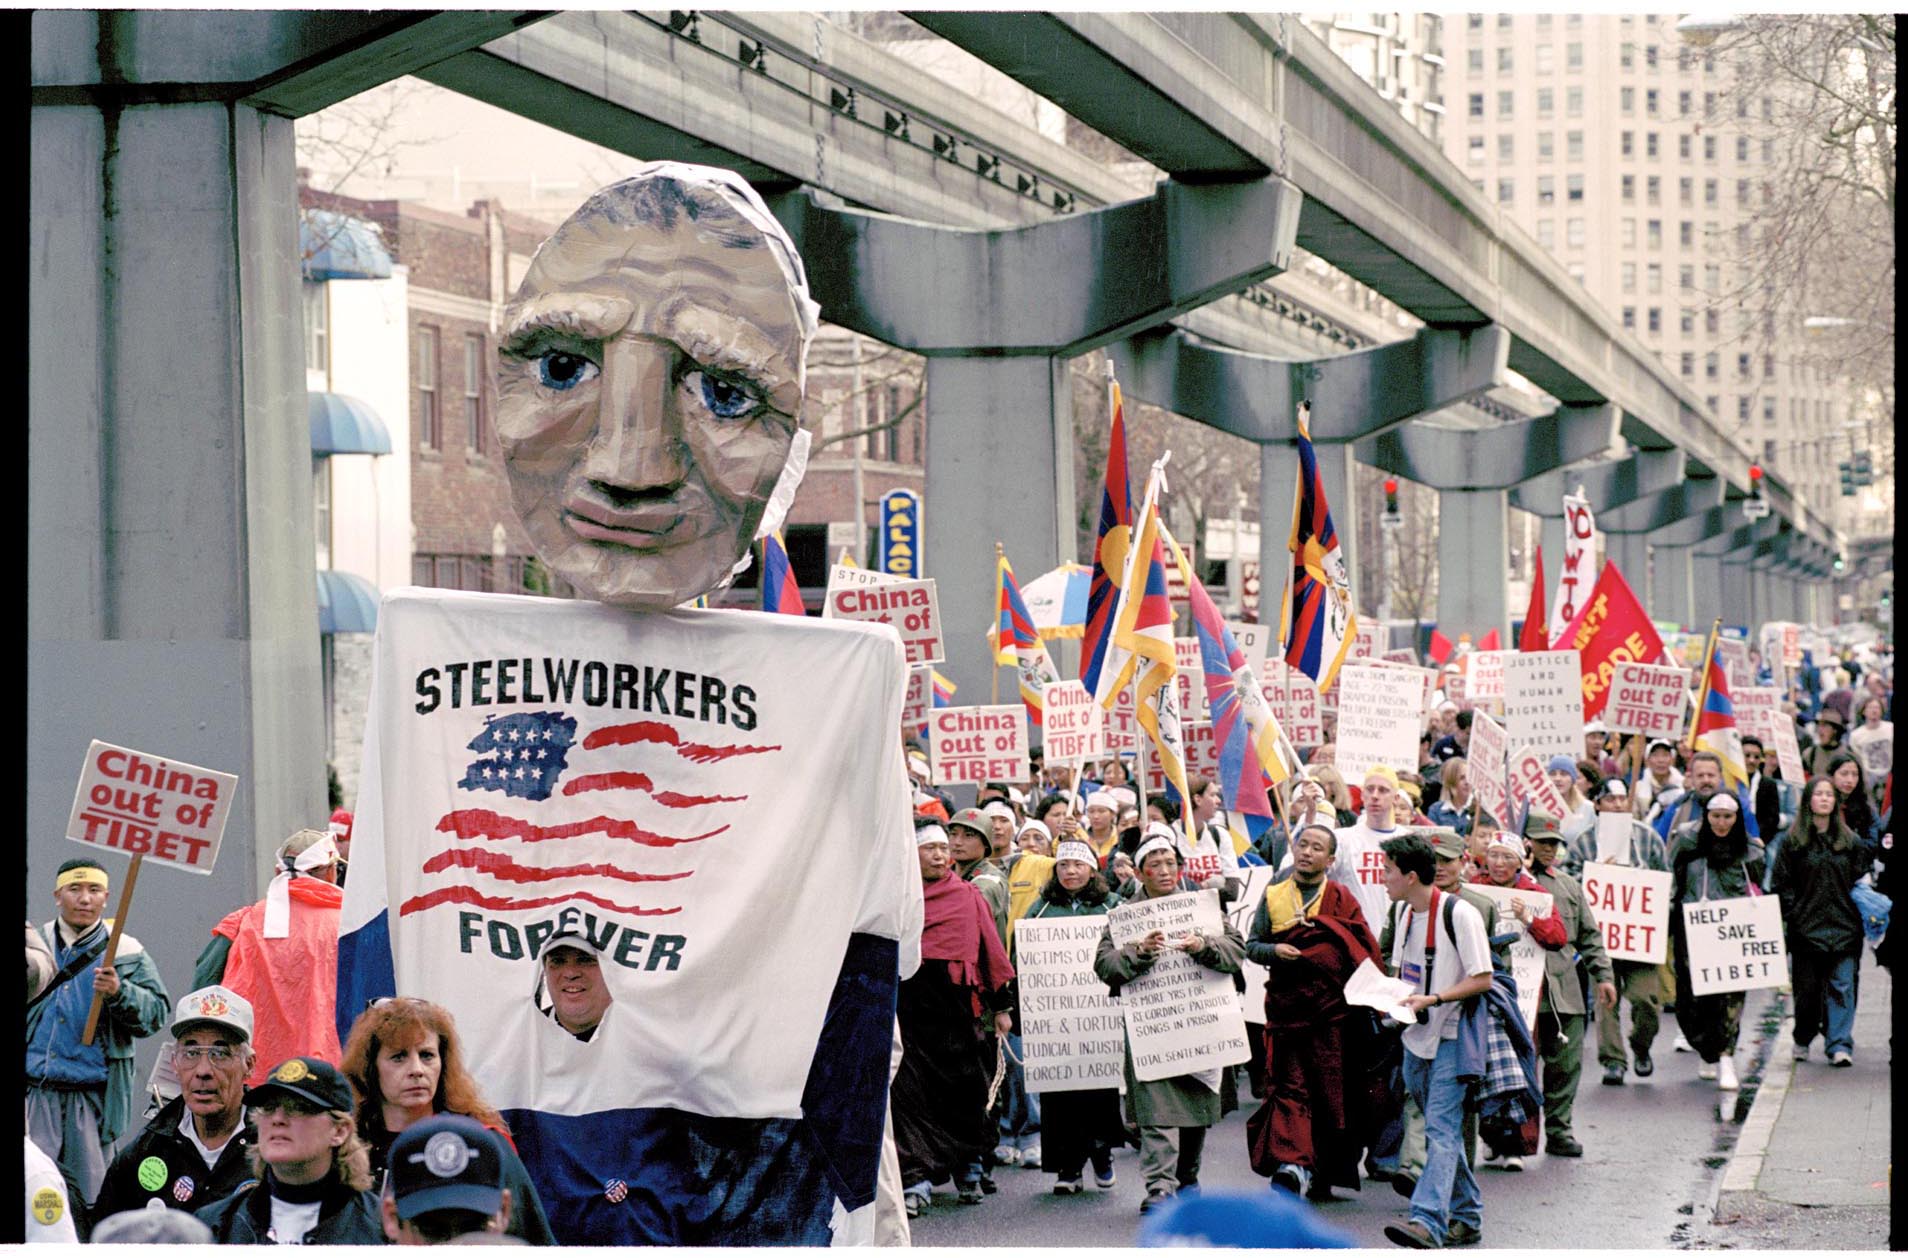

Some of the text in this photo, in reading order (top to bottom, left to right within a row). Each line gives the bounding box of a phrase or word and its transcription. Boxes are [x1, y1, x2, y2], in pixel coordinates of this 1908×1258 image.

[888, 497, 912, 579] PALAC
[838, 570, 878, 585] STOP
[835, 587, 930, 613] China
[904, 608, 930, 632] of
[1509, 656, 1571, 668] JUSTICE
[1582, 631, 1648, 702] RADE
[1623, 667, 1684, 688] China
[415, 657, 757, 731] STEELWORKERS
[1262, 685, 1314, 701] Chna
[1519, 687, 1563, 697] HUMAN
[1619, 687, 1681, 707] out of
[1049, 709, 1075, 729] out
[1300, 702, 1315, 718] of
[1507, 703, 1581, 716] RIGHTS TO
[1615, 707, 1679, 731] TIBET
[938, 713, 1016, 733] China
[1532, 721, 1557, 730] ALL
[940, 732, 1016, 754] out of
[97, 750, 219, 801] China
[939, 758, 1021, 781] TIBET
[1521, 757, 1565, 820] China
[90, 784, 215, 828] out of
[80, 813, 210, 865] TIBET
[1363, 852, 1385, 867] FR
[1586, 878, 1654, 914] SAVE
[1169, 913, 1194, 925] FROM
[1689, 908, 1729, 925] HELP
[1018, 926, 1103, 943] TIBETAN WOM
[1717, 924, 1757, 941] SAVE
[1020, 949, 1093, 965] VICTIMS OF
[1742, 940, 1780, 957] FREE
[1152, 960, 1170, 974] FOR
[1170, 960, 1180, 969] A
[1701, 963, 1769, 982] TIBET
[1019, 972, 1067, 989] FORCED
[1128, 971, 1202, 994] DEMONSTRATION
[1022, 994, 1120, 1014] & STERILIZATION
[1140, 993, 1164, 1006] MORE
[1167, 989, 1186, 1001] YRS
[1188, 985, 1206, 997] FOR
[1132, 1004, 1185, 1023] RECORDING
[1023, 1015, 1124, 1035] RAPE & TORTUR
[1135, 1013, 1219, 1038] SONGS IN PRISON
[1023, 1042, 1072, 1058] JUDICIAL
[1135, 1054, 1162, 1068] TOTAL
[1165, 1045, 1211, 1062] SENTENCE
[1227, 1038, 1244, 1049] YRS
[1025, 1062, 1121, 1082] FORCED LABOR
